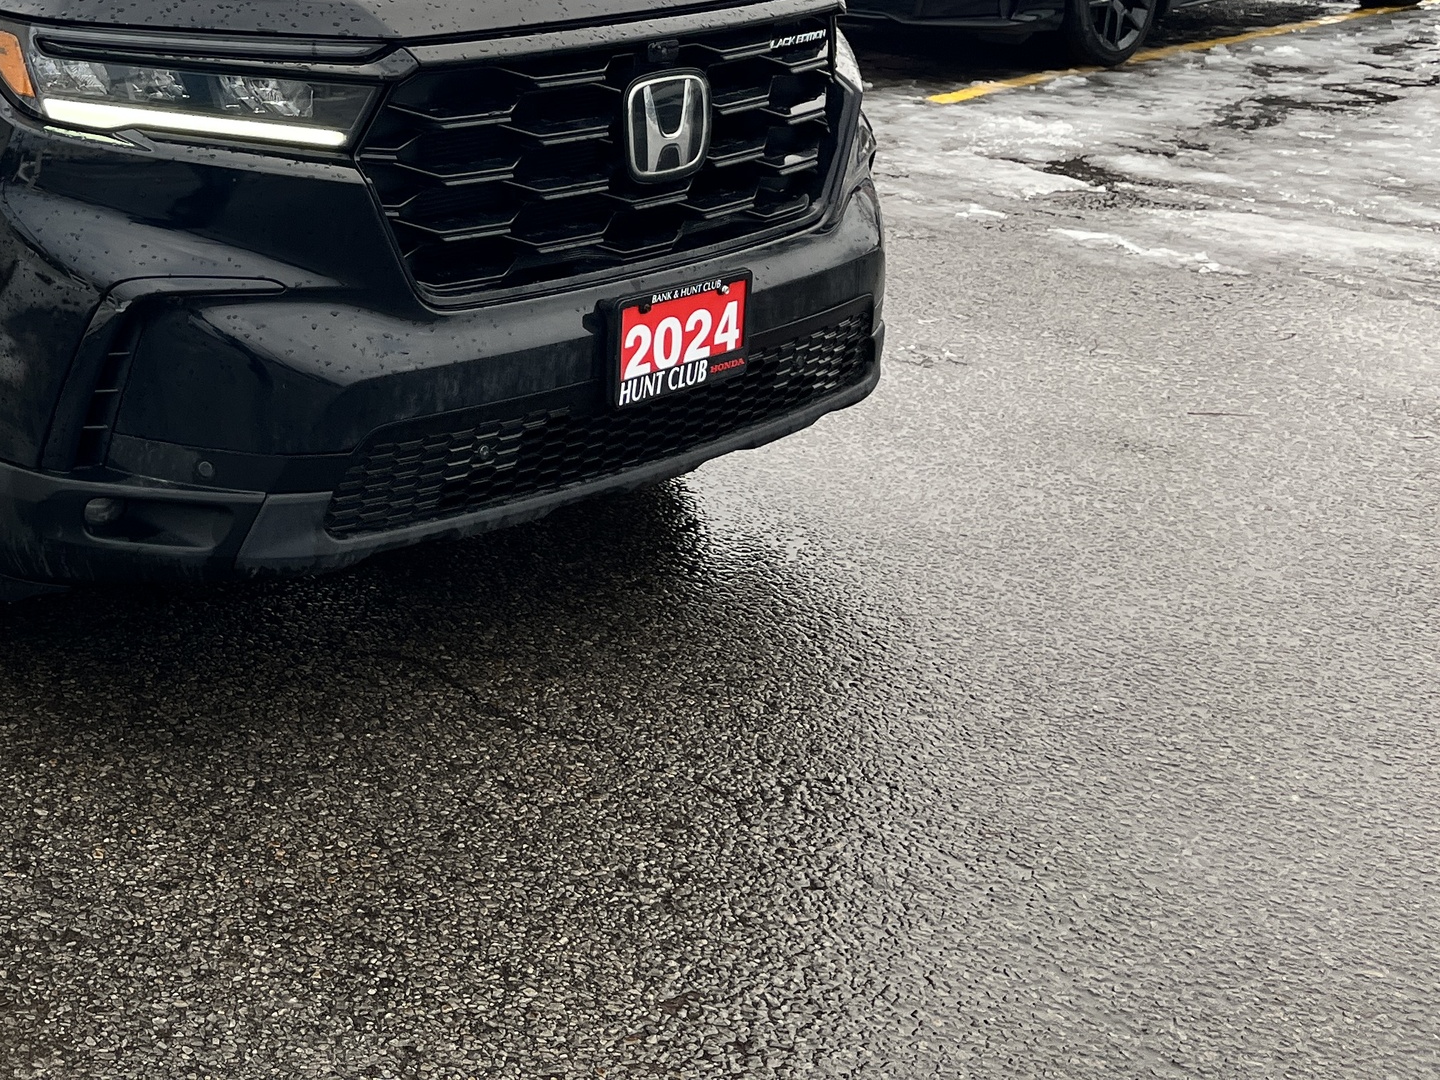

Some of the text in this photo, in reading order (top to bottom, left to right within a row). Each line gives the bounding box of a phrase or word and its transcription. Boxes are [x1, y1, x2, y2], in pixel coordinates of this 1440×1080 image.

[770, 35, 796, 49] LACK
[652, 279, 722, 304] BANK & HUNT CLUB
[623, 300, 740, 380] 2024
[618, 357, 745, 406] HUNT CLUB HONDA
